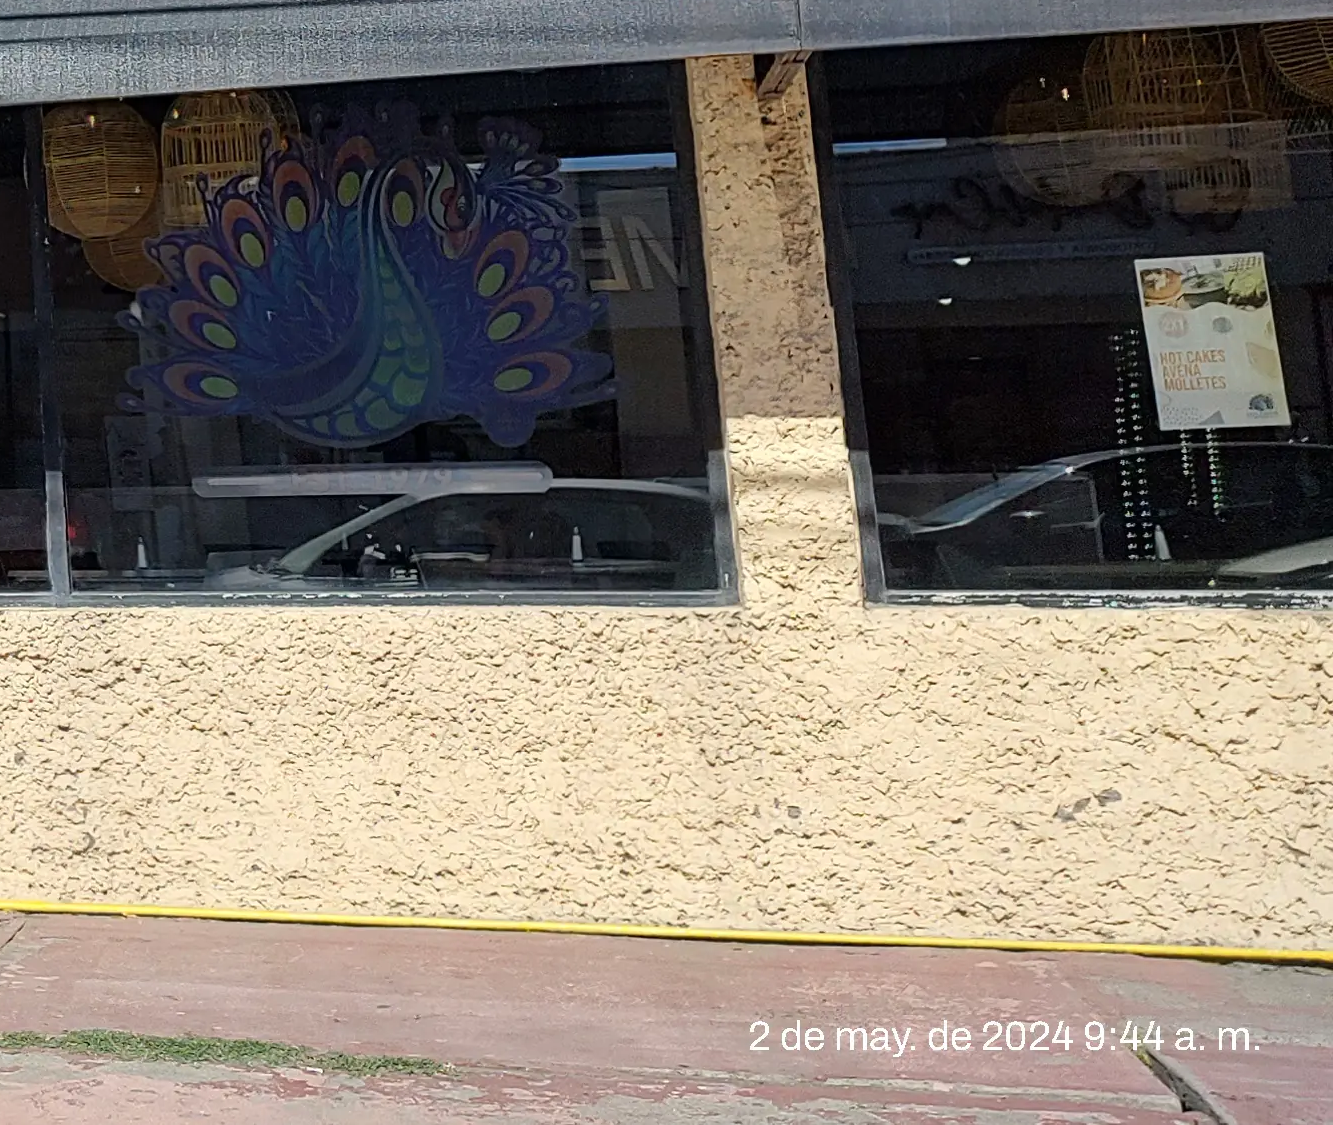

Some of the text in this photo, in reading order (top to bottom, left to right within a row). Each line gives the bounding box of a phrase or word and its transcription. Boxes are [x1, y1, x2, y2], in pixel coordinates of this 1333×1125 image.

[1160, 349, 1226, 366] HOT CAKES
[1163, 362, 1201, 378] AVENA
[1164, 376, 1227, 391] MOLLETES
[374, 468, 453, 490] 1979
